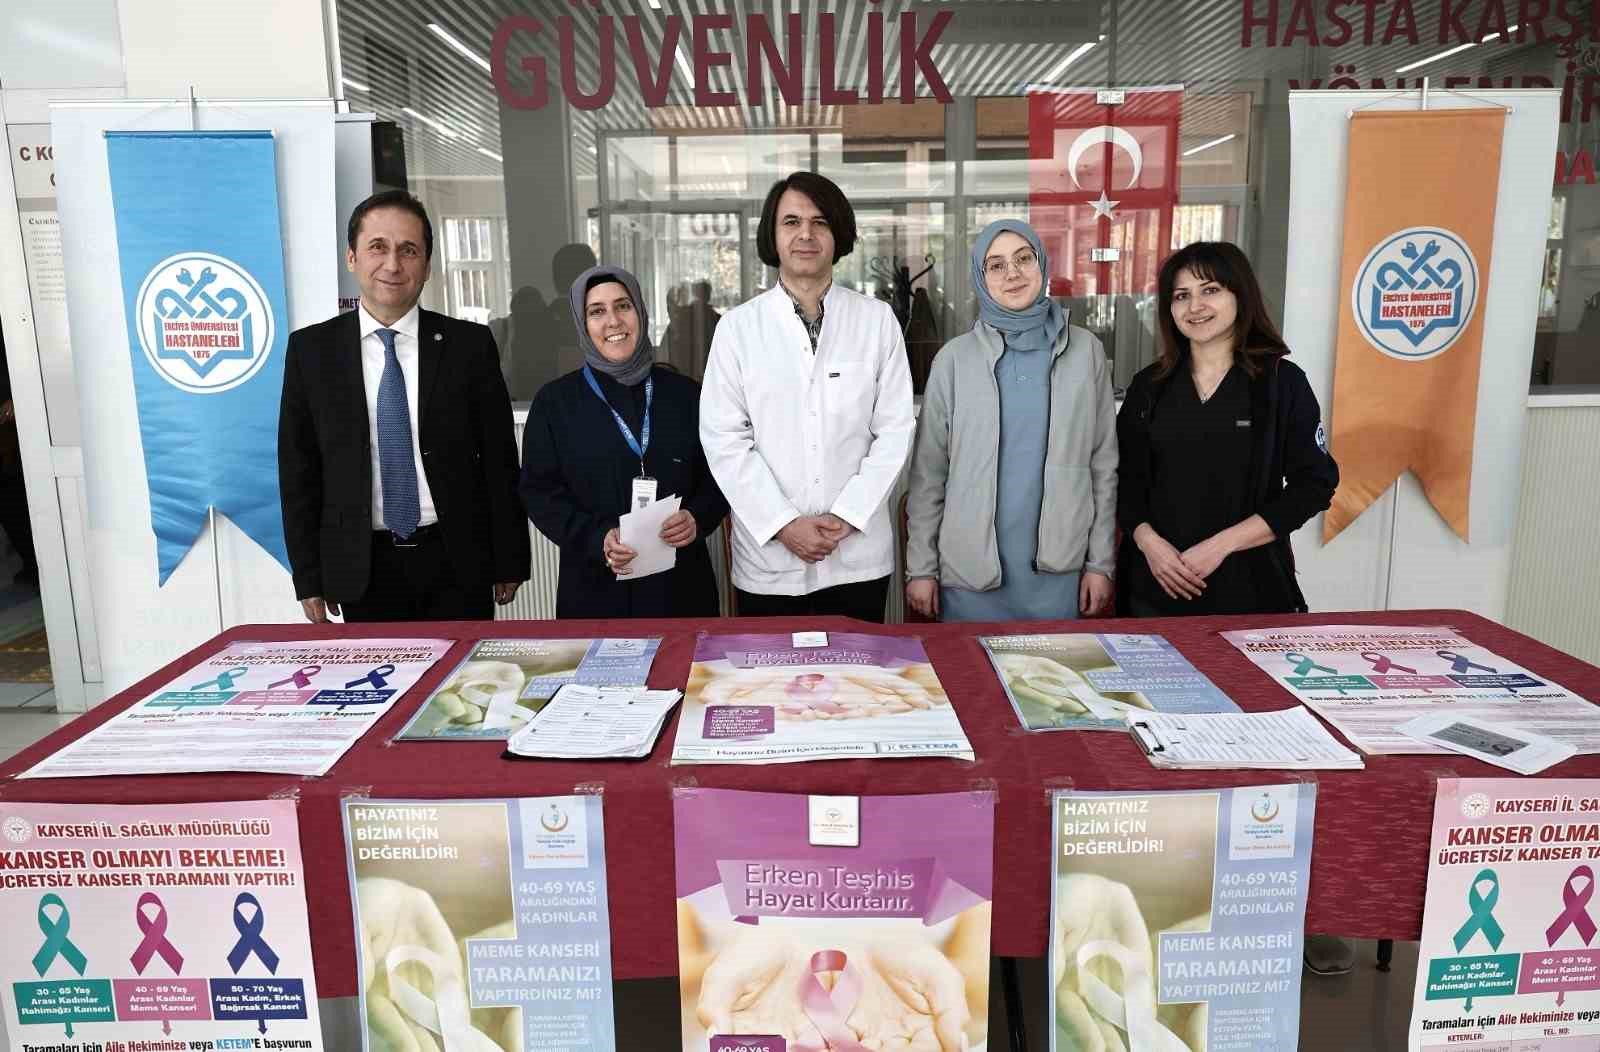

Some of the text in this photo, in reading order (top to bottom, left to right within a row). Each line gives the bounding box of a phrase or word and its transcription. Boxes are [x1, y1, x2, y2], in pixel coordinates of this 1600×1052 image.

[1241, 0, 1418, 48] HASTA
[490, 0, 954, 110] GÜVENLİK
[1382, 304, 1451, 318] HASTANELERİ
[165, 333, 240, 348] HASTANELERİ
[1064, 800, 1149, 816] HAYATINIZ
[1495, 797, 1557, 813] KAYSERİ
[1562, 796, 1574, 812] İL
[355, 808, 438, 821] HAYATINIZ
[38, 819, 271, 838] KAYSERİ İL SAĞLIK MÜDÜRLÜĞÜ
[357, 824, 439, 844] BİZİM İÇİN
[1064, 818, 1147, 837] BİZİM İÇİN
[1448, 825, 1532, 846] KANSER
[359, 843, 458, 861] DEĞERLİDİR!
[1064, 838, 1163, 856] DEĞERLİDİR!
[0, 848, 286, 869] KANSER OLMAYI BEKLEME!
[1438, 846, 1512, 866] ÜCRETSİZ
[1517, 846, 1581, 862] KANSER
[78, 873, 143, 888] KANSER
[146, 872, 230, 887] TARAMANI
[233, 872, 295, 887] YAPTIR!
[746, 863, 913, 893] Erken Teşhis
[1222, 870, 1298, 886] 40-69 YAŞ
[520, 881, 596, 896] 40-69 YAŞ
[1220, 886, 1297, 898] ARALIĞINDAKİ
[746, 888, 913, 912] Hayat Kurtarır.
[1219, 902, 1295, 916] KADINLAR
[521, 911, 598, 924] KADINLAR
[473, 942, 599, 958] MEME KANSERİ
[1164, 932, 1293, 953] MEME KANSERİ
[1483, 961, 1500, 971] Yaş
[1575, 956, 1592, 965] Yaş
[473, 966, 601, 982] TARAMANIZI
[1164, 958, 1292, 979] TARAMANIZI
[1467, 970, 1505, 980] Kadınlar
[1559, 965, 1598, 974] Kadınlar
[1478, 979, 1513, 988] Kanseri
[1531, 973, 1597, 985] Meme Kanseri
[74, 986, 91, 997] Yaş
[136, 986, 149, 994] 40
[171, 985, 188, 996] Yaş
[253, 985, 265, 993] 70
[267, 985, 284, 995] Yaş
[476, 988, 601, 1001] YAPTIRDINIZ MI?
[1164, 980, 1290, 999] YAPTIRDINIZ MI?
[31, 995, 99, 1005] Arası Kadınlar
[130, 994, 195, 1003] Arası Kadınlar
[74, 1004, 111, 1014] Kanseri
[131, 1003, 197, 1012] Meme Kanseri
[220, 1001, 300, 1013] Bağırsak Kanseri
[1422, 1010, 1600, 1031] Taramaları için Aile Hekiminize veya
[23, 1042, 80, 1052] Taramaları
[106, 1040, 126, 1051] Aile
[128, 1039, 186, 1051] Hekiminize
[189, 1040, 213, 1052] veya
[216, 1038, 261, 1050] KETEM'E
[264, 1037, 312, 1052] başvurun
